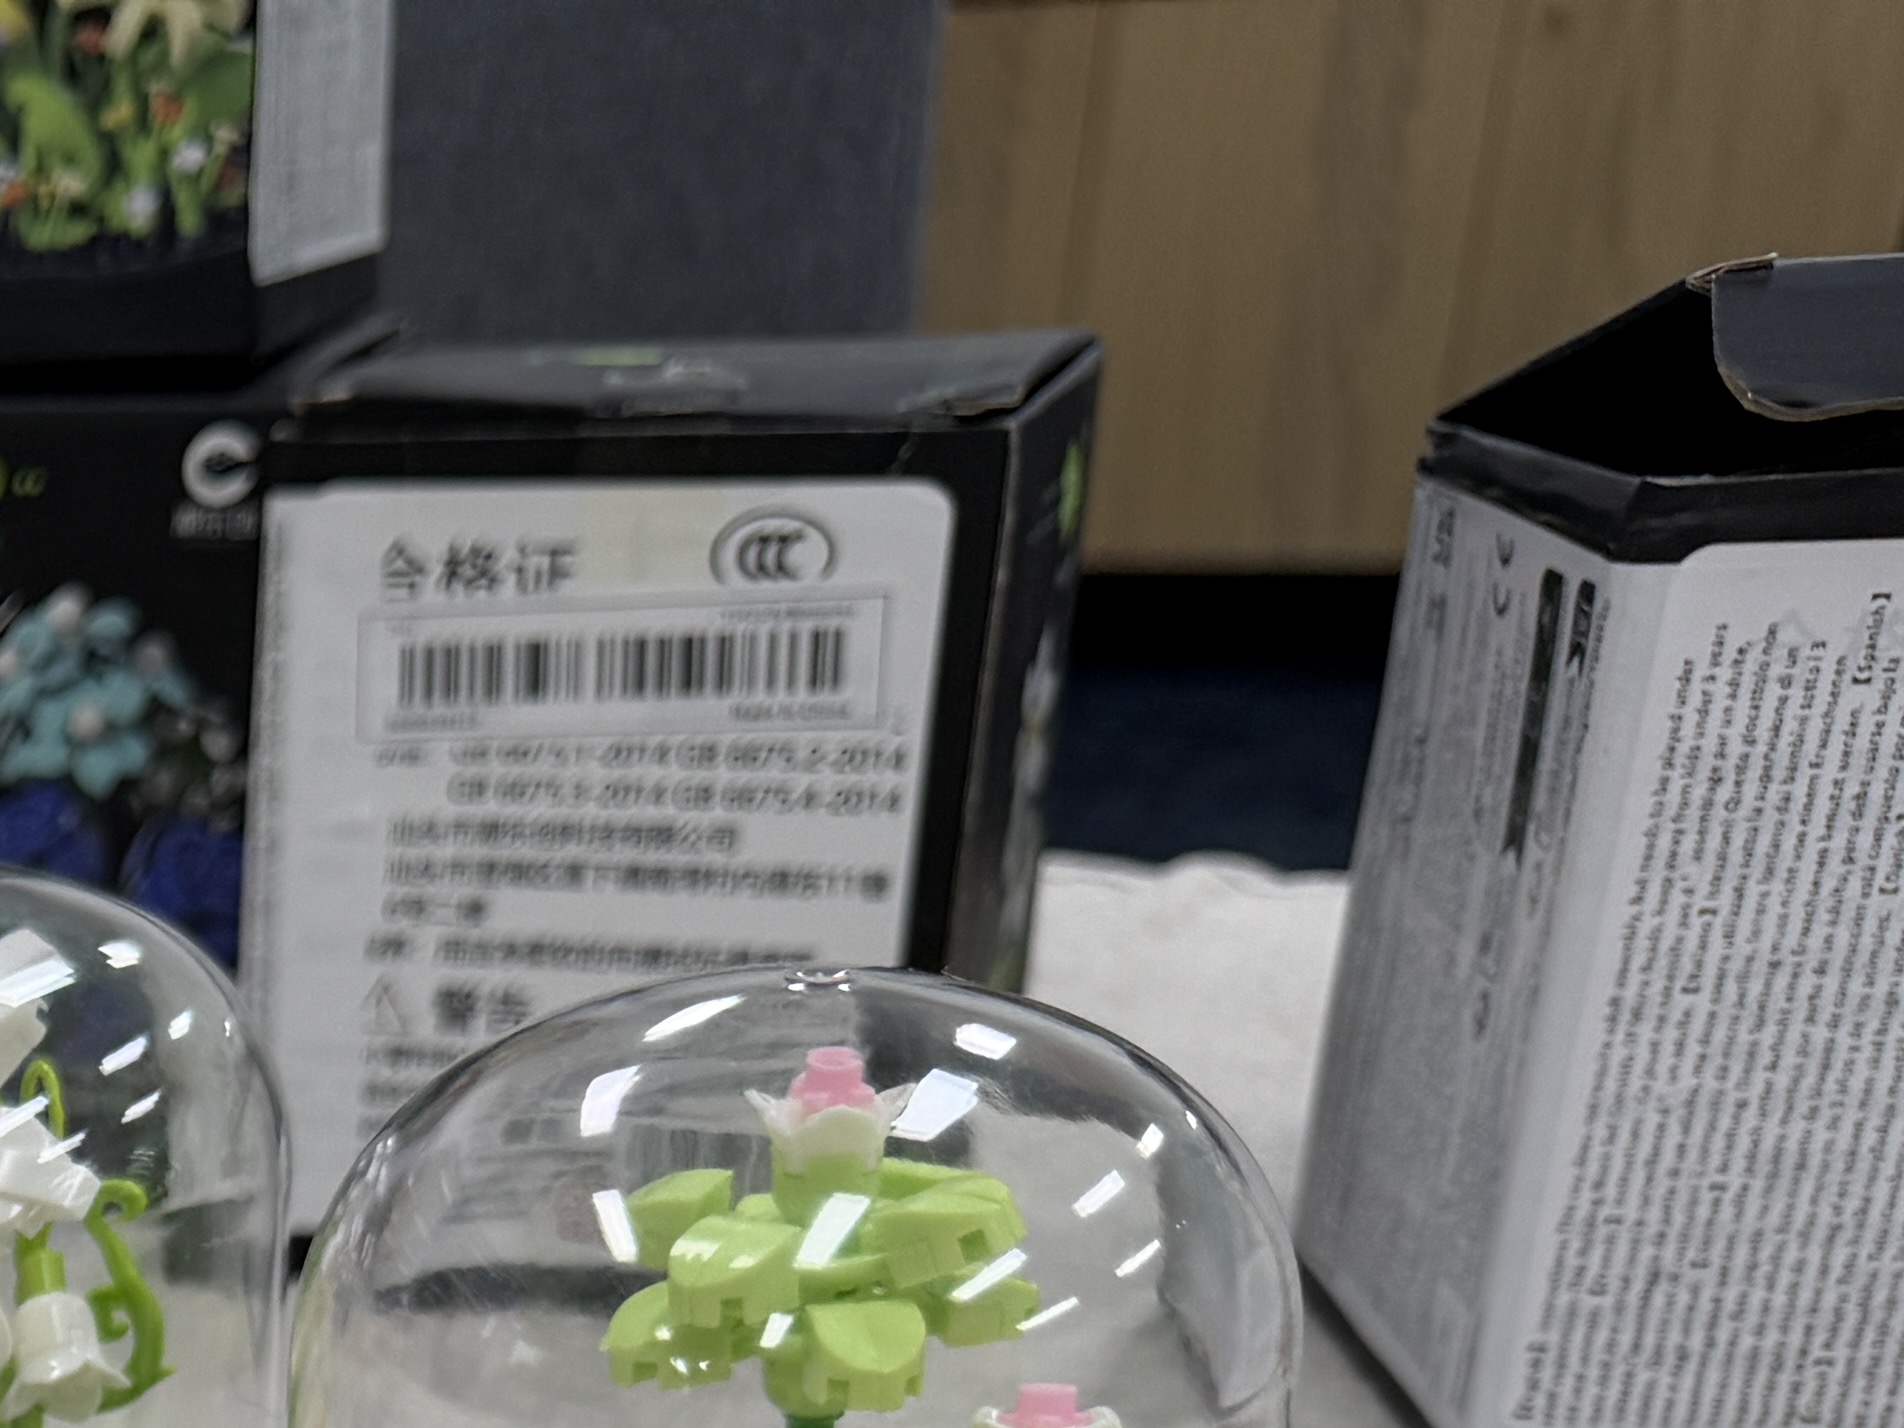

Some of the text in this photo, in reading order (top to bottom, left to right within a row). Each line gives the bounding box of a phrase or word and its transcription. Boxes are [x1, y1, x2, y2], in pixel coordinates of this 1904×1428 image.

[380, 534, 580, 604] 合格证
[1707, 622, 1732, 669] years
[1783, 645, 1800, 669] un
[1810, 639, 1828, 651] 3
[1881, 656, 1901, 673] la
[1670, 657, 1696, 709] under
[1700, 674, 1718, 684] 3
[1775, 672, 1794, 690] di
[1796, 664, 1822, 710] sotto
[1871, 676, 1899, 715] bajo
[1688, 688, 1714, 740] under
[1719, 705, 1736, 729] un
[1722, 751, 1751, 813] Questo
[1737, 659, 1775, 747] giocattolo
[1761, 621, 1780, 656] non
[1656, 713, 1687, 771] played
[1712, 732, 1733, 760] par
[1750, 694, 1792, 802] supervisione
[1779, 714, 1810, 785] bambini
[1794, 773, 1822, 828] einem
[1808, 654, 1850, 769] Erwachsenen
[1679, 743, 1702, 779] kids
[1651, 774, 1670, 796] be
[1670, 782, 1694, 824] from
[1772, 789, 1793, 815] dai
[1847, 779, 1872, 821] debe
[1646, 800, 1665, 818] to
[1745, 806, 1764, 822] la
[1839, 825, 1863, 865] pero
